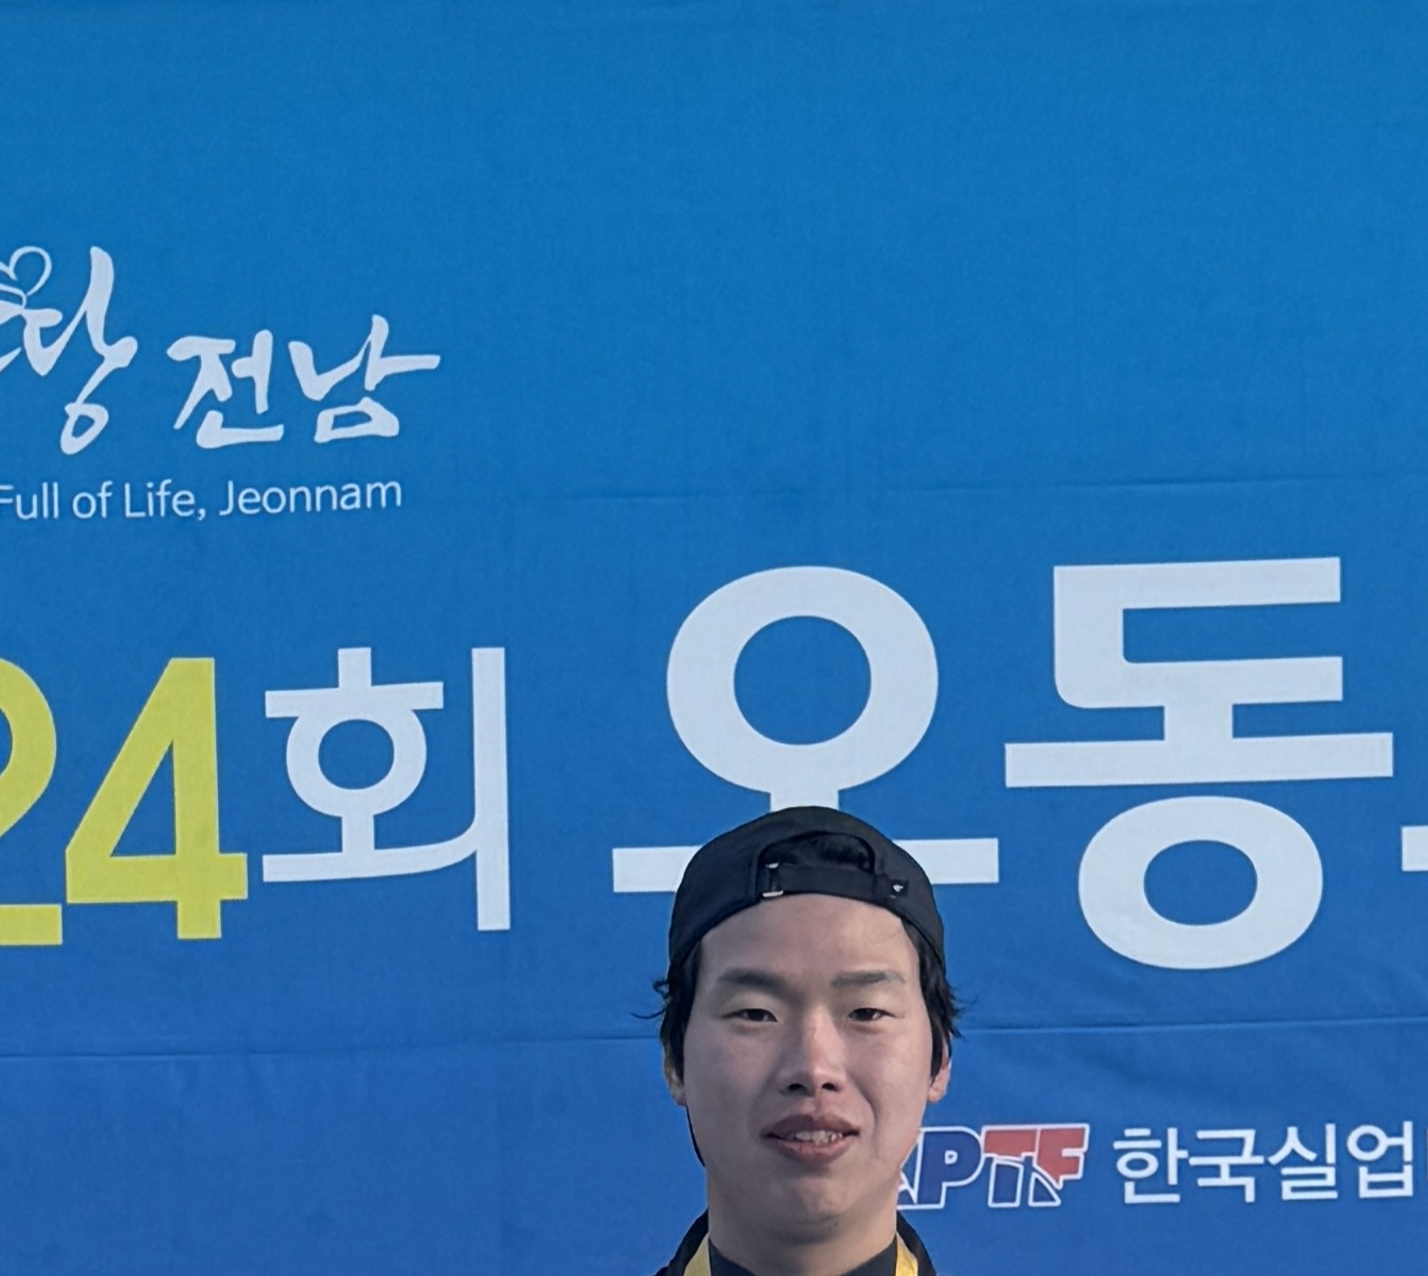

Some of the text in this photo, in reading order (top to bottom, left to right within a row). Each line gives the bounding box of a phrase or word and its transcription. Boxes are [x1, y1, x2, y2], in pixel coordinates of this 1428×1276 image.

[167, 315, 441, 449] 전남
[72, 479, 113, 520] of
[122, 478, 208, 523] Life,
[217, 478, 403, 520] Jeonnam
[897, 1123, 1089, 1208] PTF
